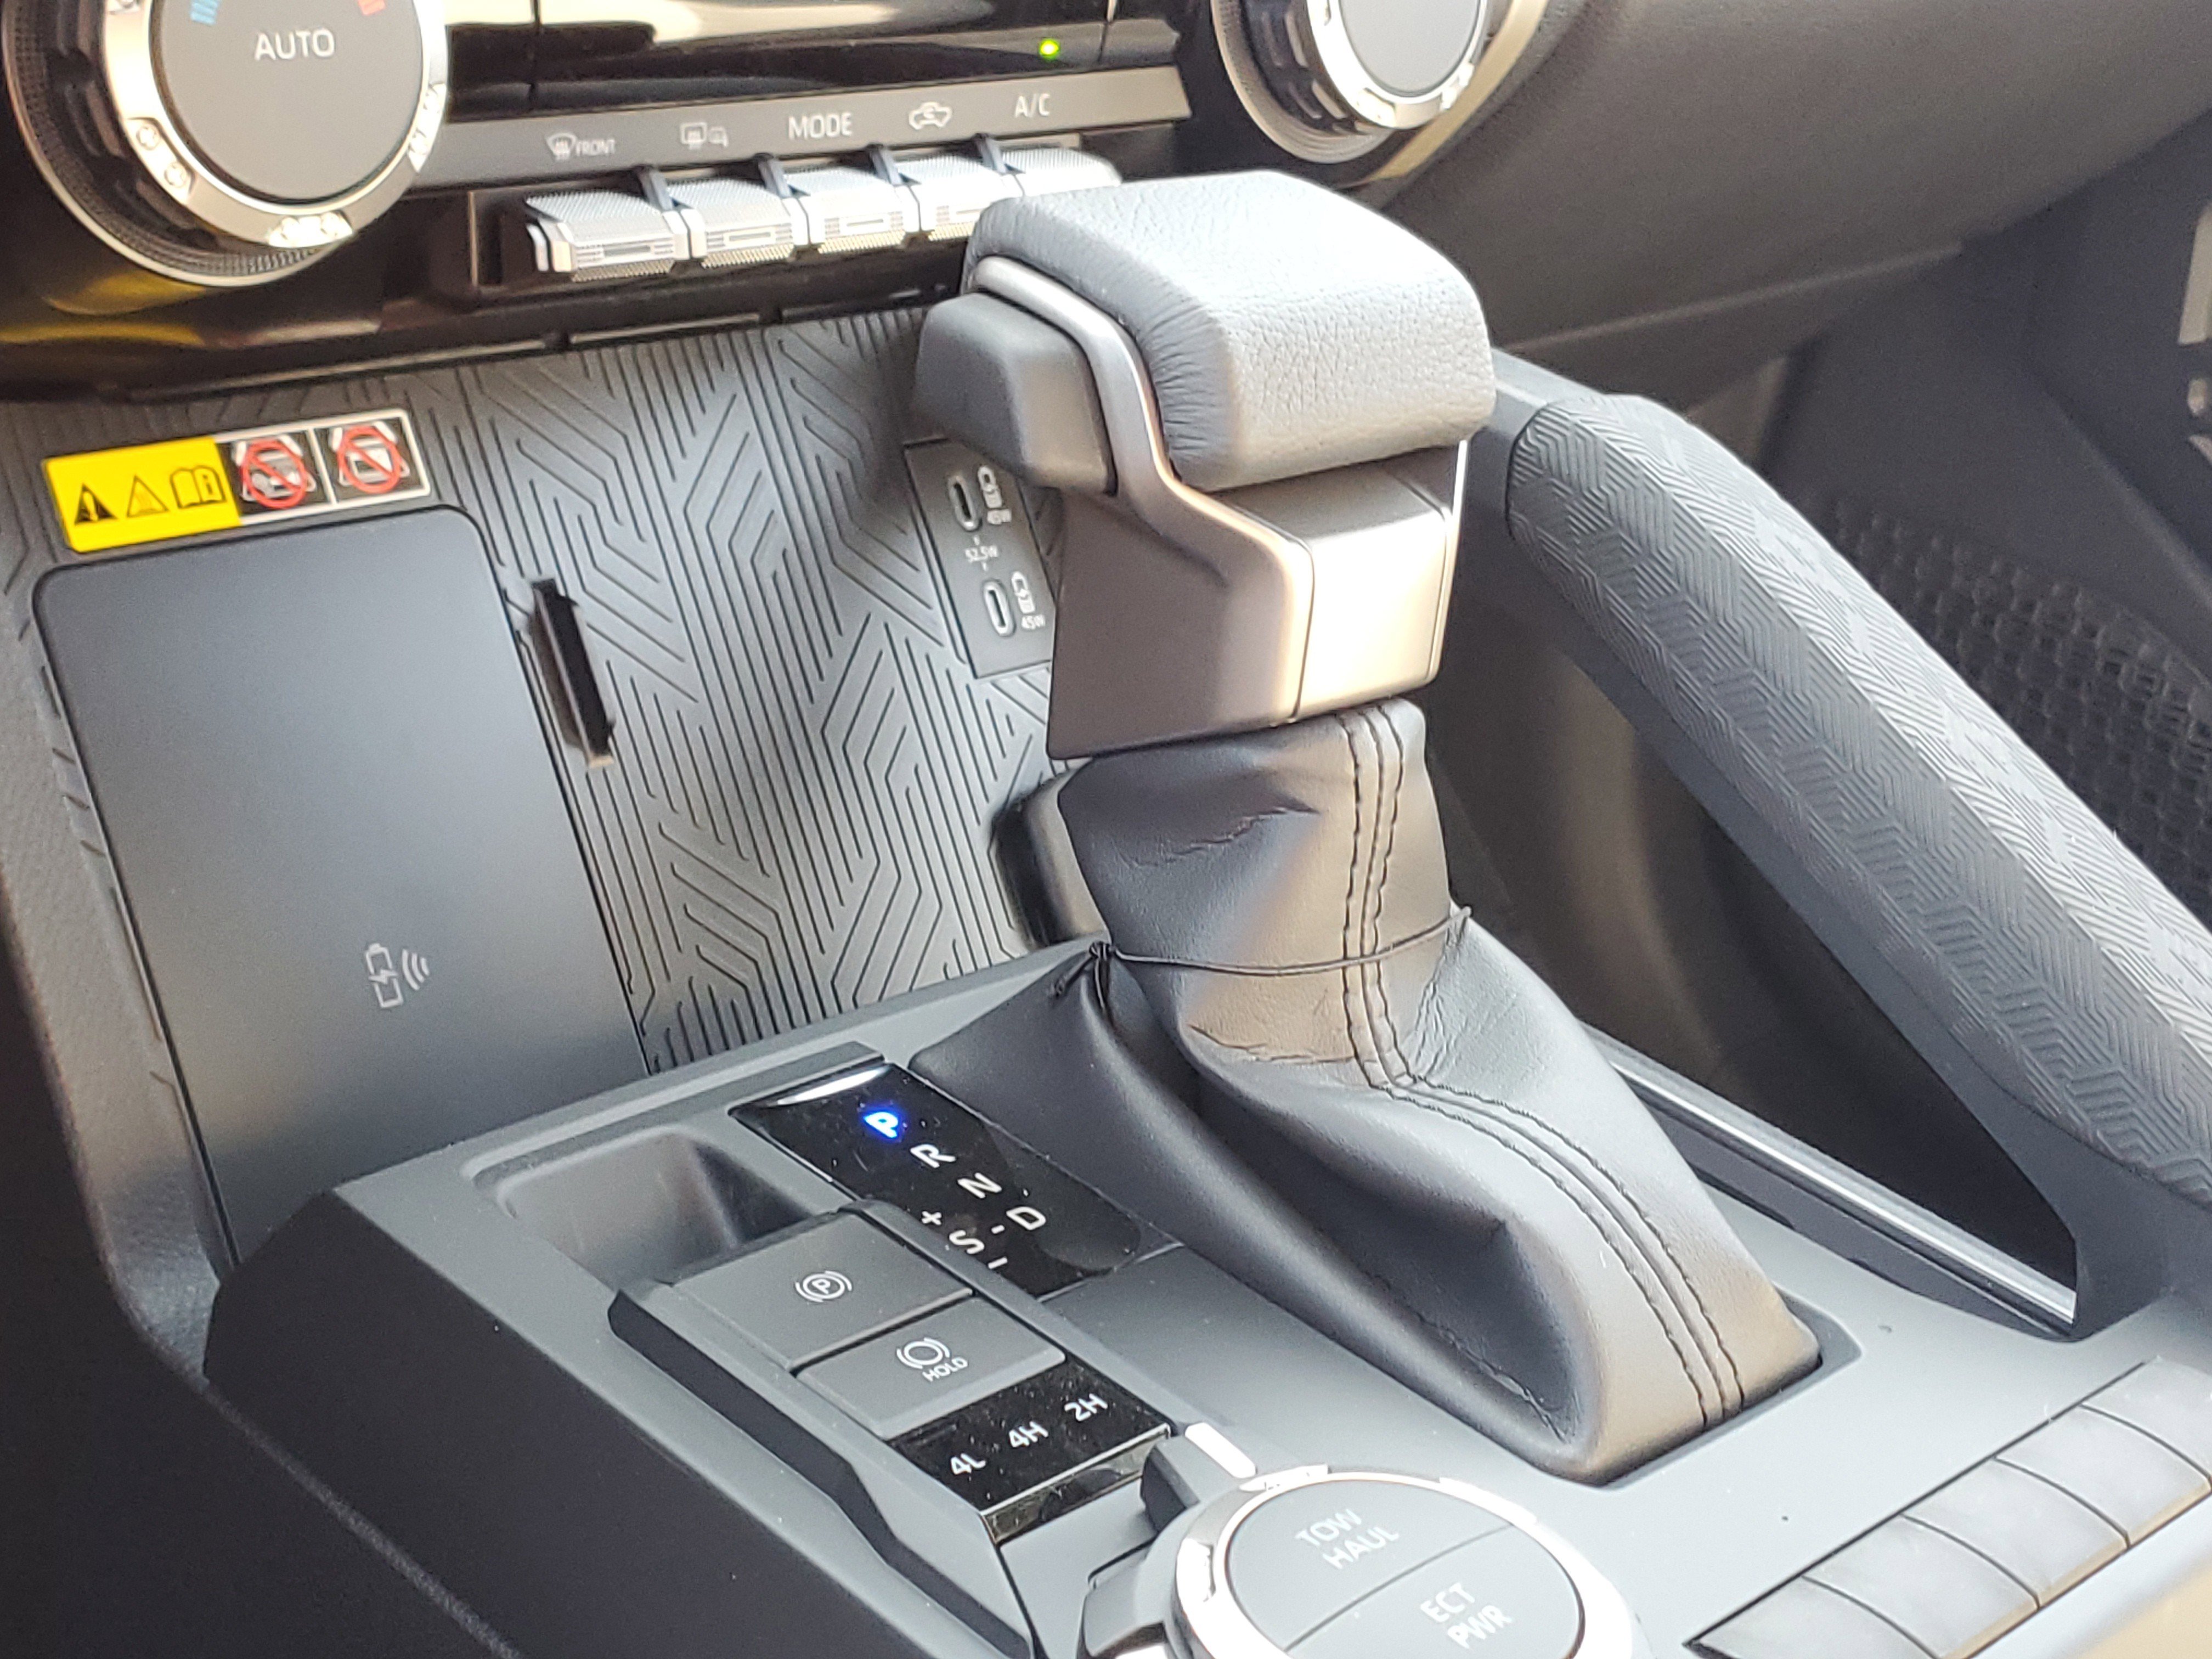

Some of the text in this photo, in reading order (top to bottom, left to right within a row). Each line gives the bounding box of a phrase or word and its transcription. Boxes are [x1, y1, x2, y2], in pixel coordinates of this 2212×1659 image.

[255, 28, 334, 61] AUTO
[1015, 93, 1050, 117] A/C
[788, 112, 852, 140] MODE
[576, 139, 615, 156] FRONT
[864, 1111, 899, 1138] P
[910, 1144, 957, 1168] R
[957, 1172, 1002, 1199] N
[1006, 1207, 1046, 1231] D
[949, 1230, 984, 1254] S
[812, 1279, 831, 1294] P
[922, 1357, 968, 1382] HOLD
[1064, 1393, 1108, 1421] 2H
[1008, 1421, 1048, 1448] 4H
[950, 1453, 986, 1475] 4L
[1295, 1509, 1362, 1546] TOW
[1322, 1526, 1399, 1570] HAUL
[1420, 1582, 1475, 1623] ECT
[1447, 1605, 1513, 1649] PWR
